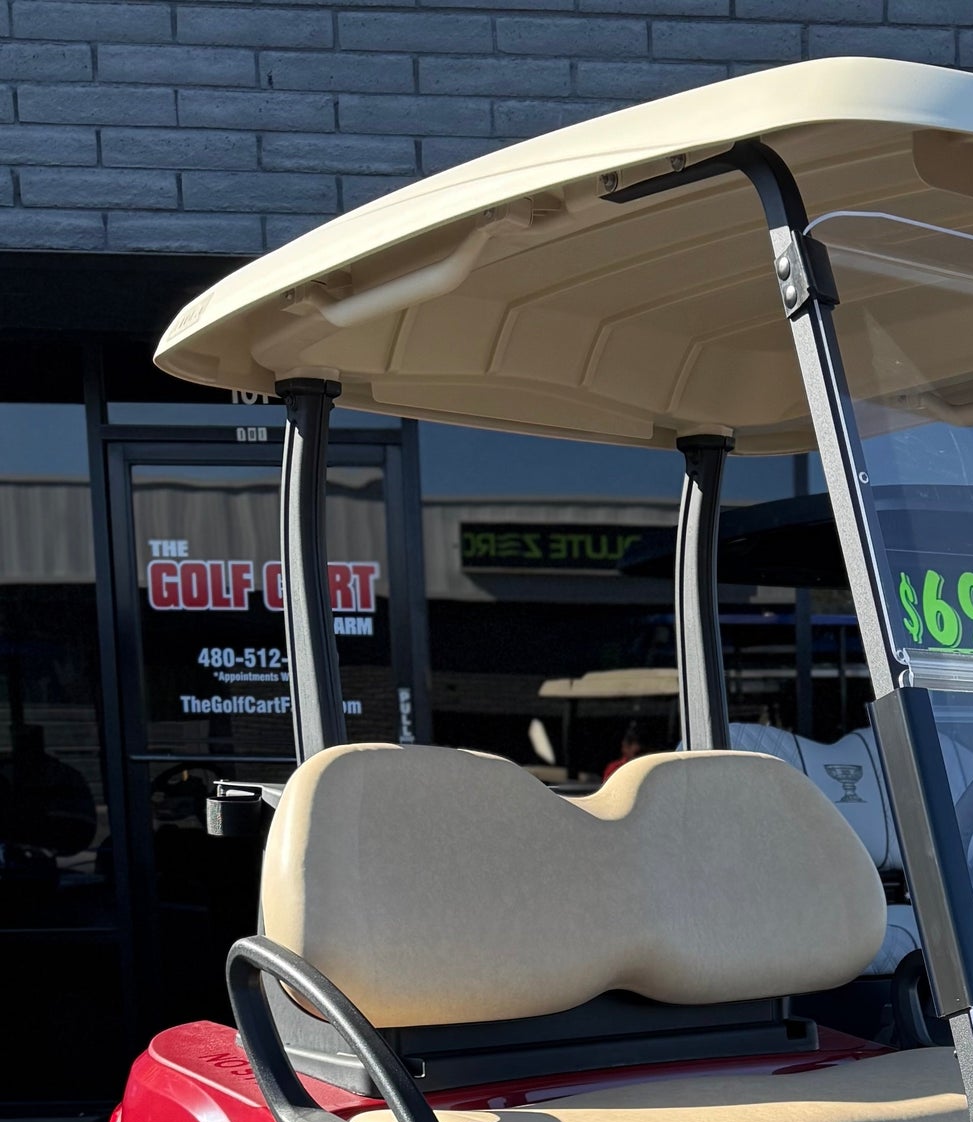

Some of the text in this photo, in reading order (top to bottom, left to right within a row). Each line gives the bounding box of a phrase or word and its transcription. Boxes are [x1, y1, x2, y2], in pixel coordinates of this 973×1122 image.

[148, 540, 189, 557] THE
[147, 560, 380, 613] GOLF CRT
[333, 616, 374, 636] ARM
[198, 648, 289, 668] 480-512-
[399, 689, 412, 737] PULL
